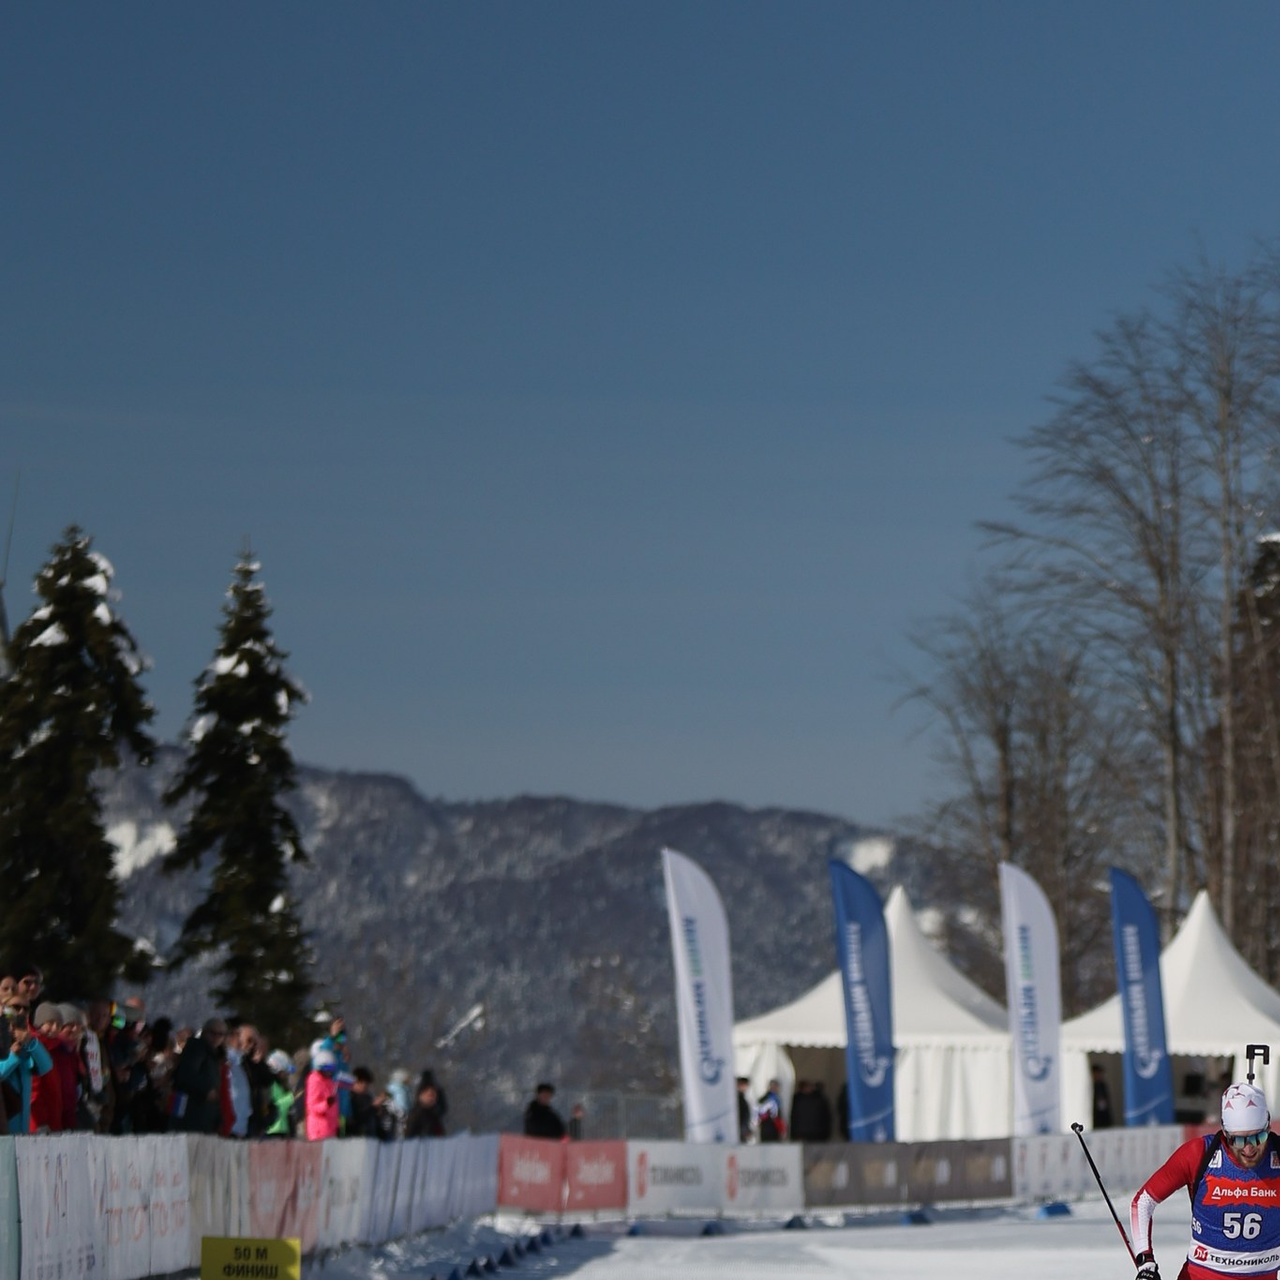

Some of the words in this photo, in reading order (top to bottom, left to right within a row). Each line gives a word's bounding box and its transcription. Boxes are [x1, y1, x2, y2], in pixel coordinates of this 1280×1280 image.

[1212, 1186, 1248, 1199] Альфа
[1250, 1186, 1277, 1198] Банк
[1222, 1212, 1263, 1240] 56
[234, 1246, 251, 1261] 50
[1210, 1254, 1280, 1266] ТЕХНОНИКОЛЬ
[223, 1263, 279, 1279] ФИНИШ
